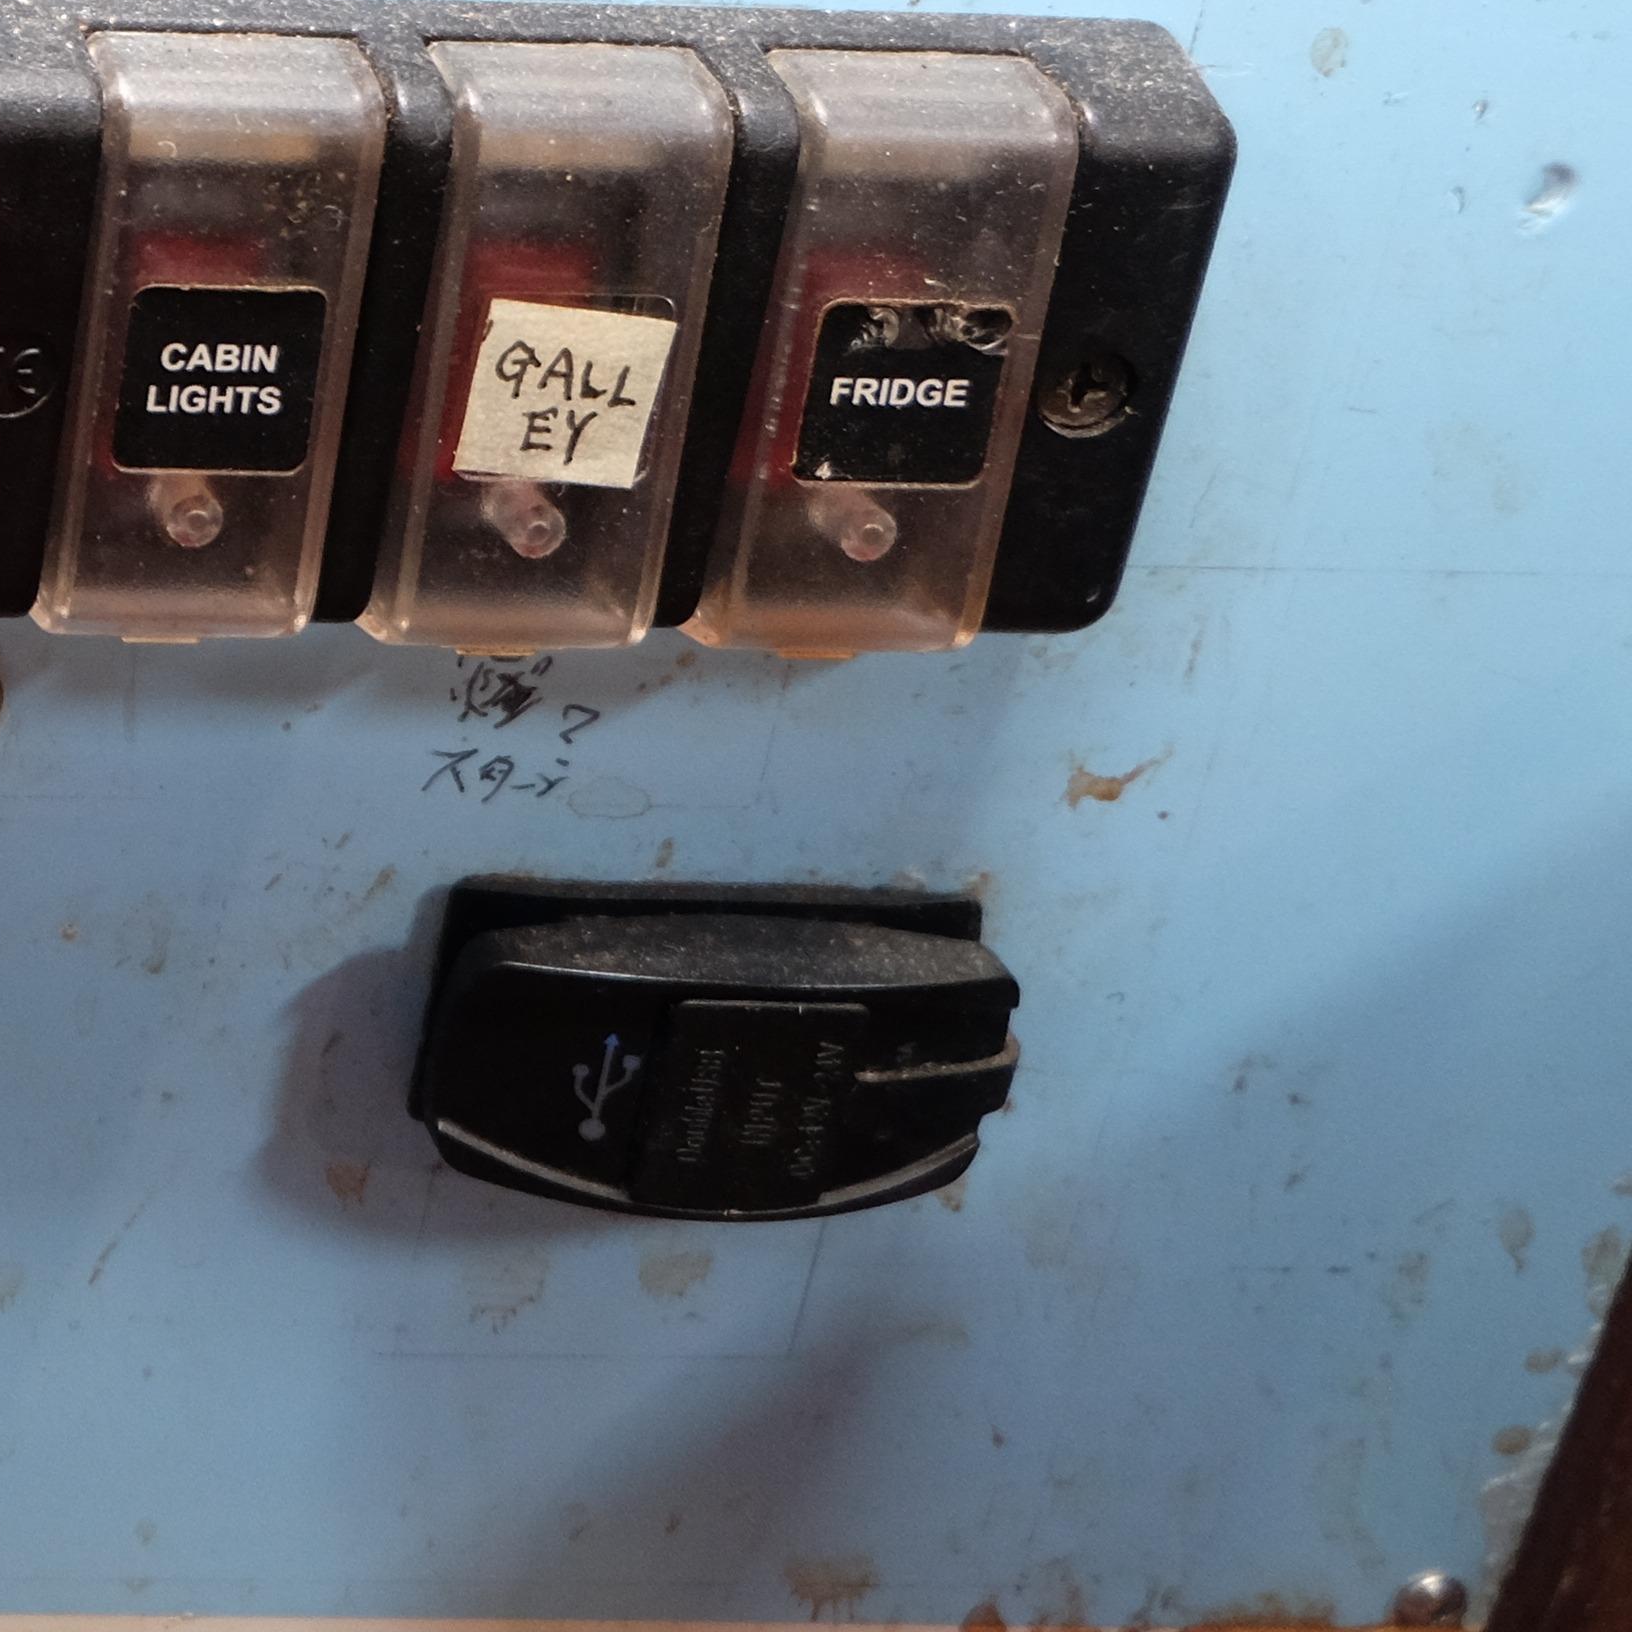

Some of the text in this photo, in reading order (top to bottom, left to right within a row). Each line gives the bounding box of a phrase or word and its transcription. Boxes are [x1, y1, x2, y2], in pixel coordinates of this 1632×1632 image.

[159, 341, 280, 374] CABIN
[494, 339, 637, 409] GALL
[145, 383, 283, 416] LIGHTS
[828, 376, 971, 409] FRIDGE
[518, 406, 599, 466] EY
